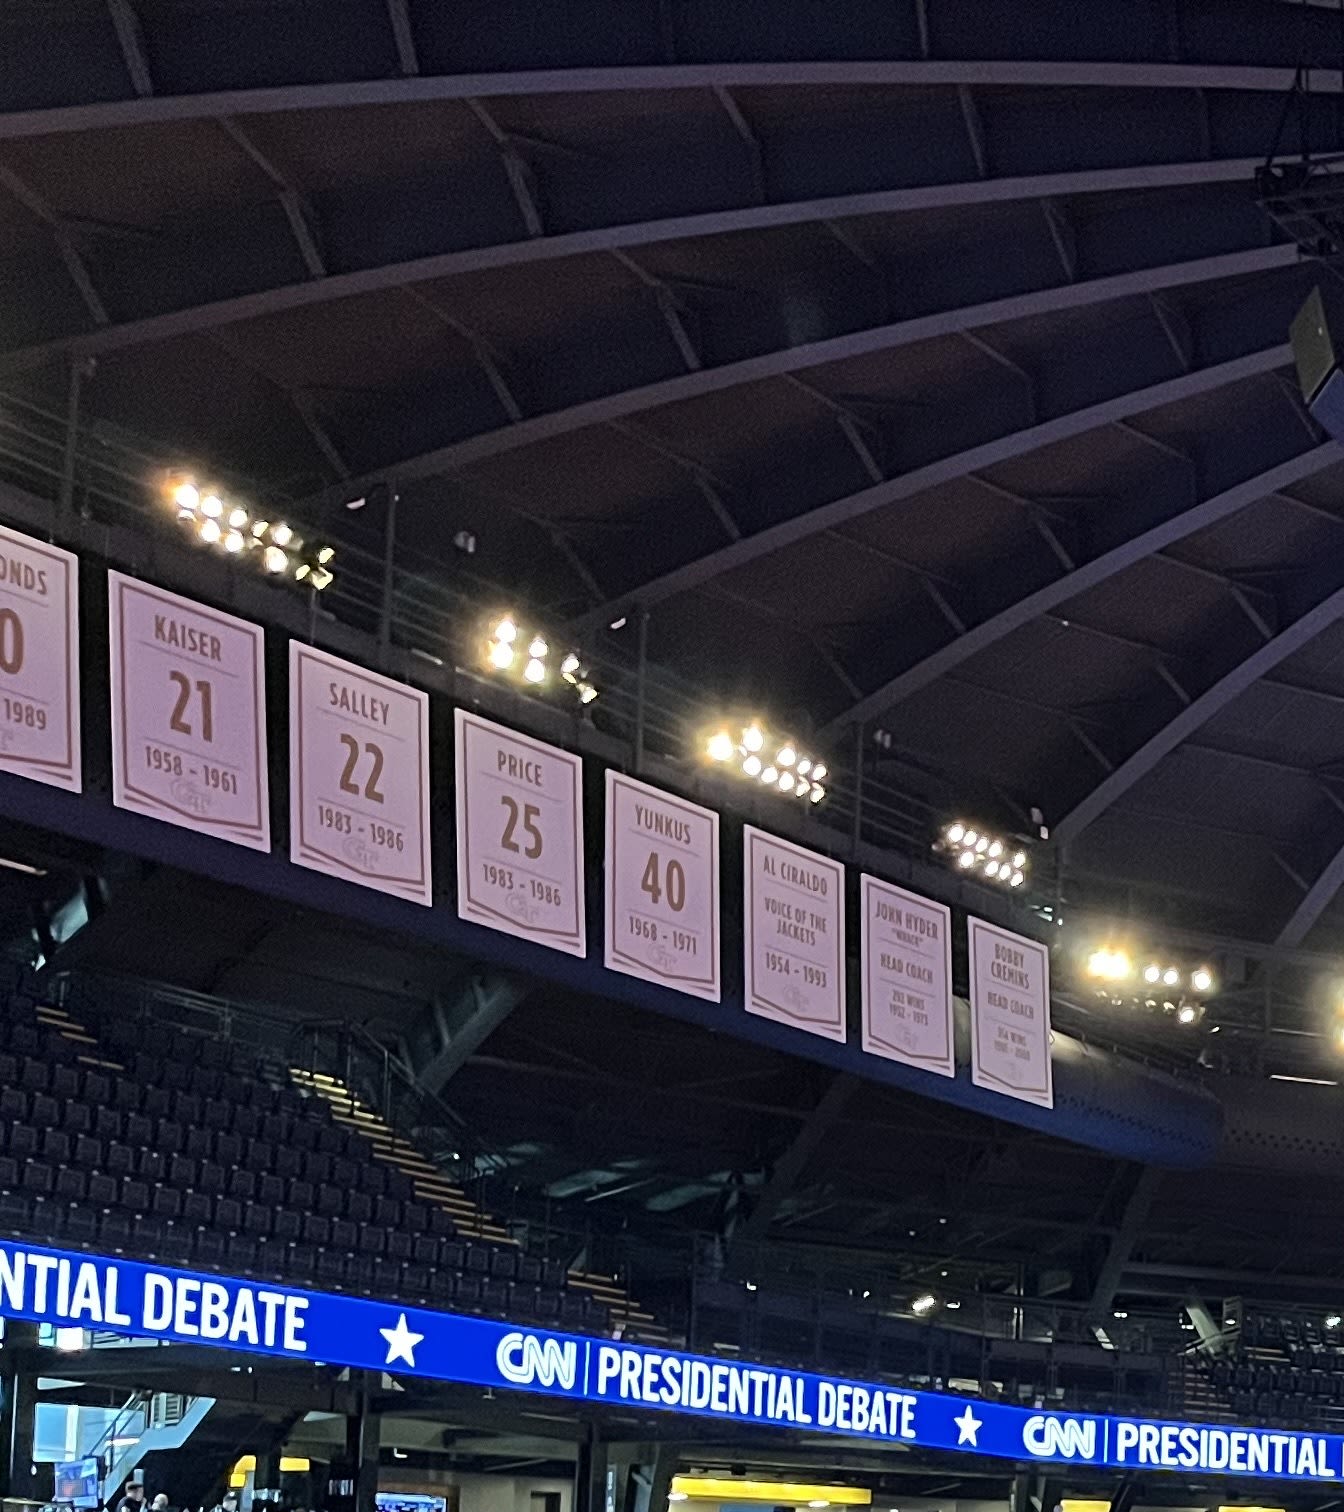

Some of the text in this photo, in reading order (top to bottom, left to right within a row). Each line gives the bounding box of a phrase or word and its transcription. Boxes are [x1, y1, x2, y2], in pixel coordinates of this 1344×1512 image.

[154, 614, 222, 662] KAISER
[4, 698, 46, 730] 1989
[169, 670, 213, 743] 21
[329, 683, 390, 726] SALLEY
[145, 745, 237, 795] 1958 1961
[340, 733, 384, 804] 22
[497, 750, 543, 786] PRICE
[318, 805, 404, 852] 1983 1986
[501, 795, 543, 859] 25
[635, 804, 691, 845] YUNKUS
[482, 864, 561, 906] 1983 1986
[641, 851, 685, 912] 40
[763, 855, 828, 897] AL CIRALDO
[629, 916, 697, 955] 1968 1971
[764, 897, 827, 934] VOICE OF THE
[776, 918, 816, 946] JACKETS
[875, 901, 938, 940] JOHN HYDER
[765, 952, 827, 988] 1954 1993
[880, 953, 934, 985] HEAD COACH
[1009, 1000, 1034, 1020] COACH
[143, 1273, 309, 1351] DEBATE
[496, 1332, 917, 1439] CNN PRESIDENTIAL DEBATE
[1023, 1415, 1096, 1459] CNN
[1117, 1422, 1335, 1477] PRESIDENTIAL
